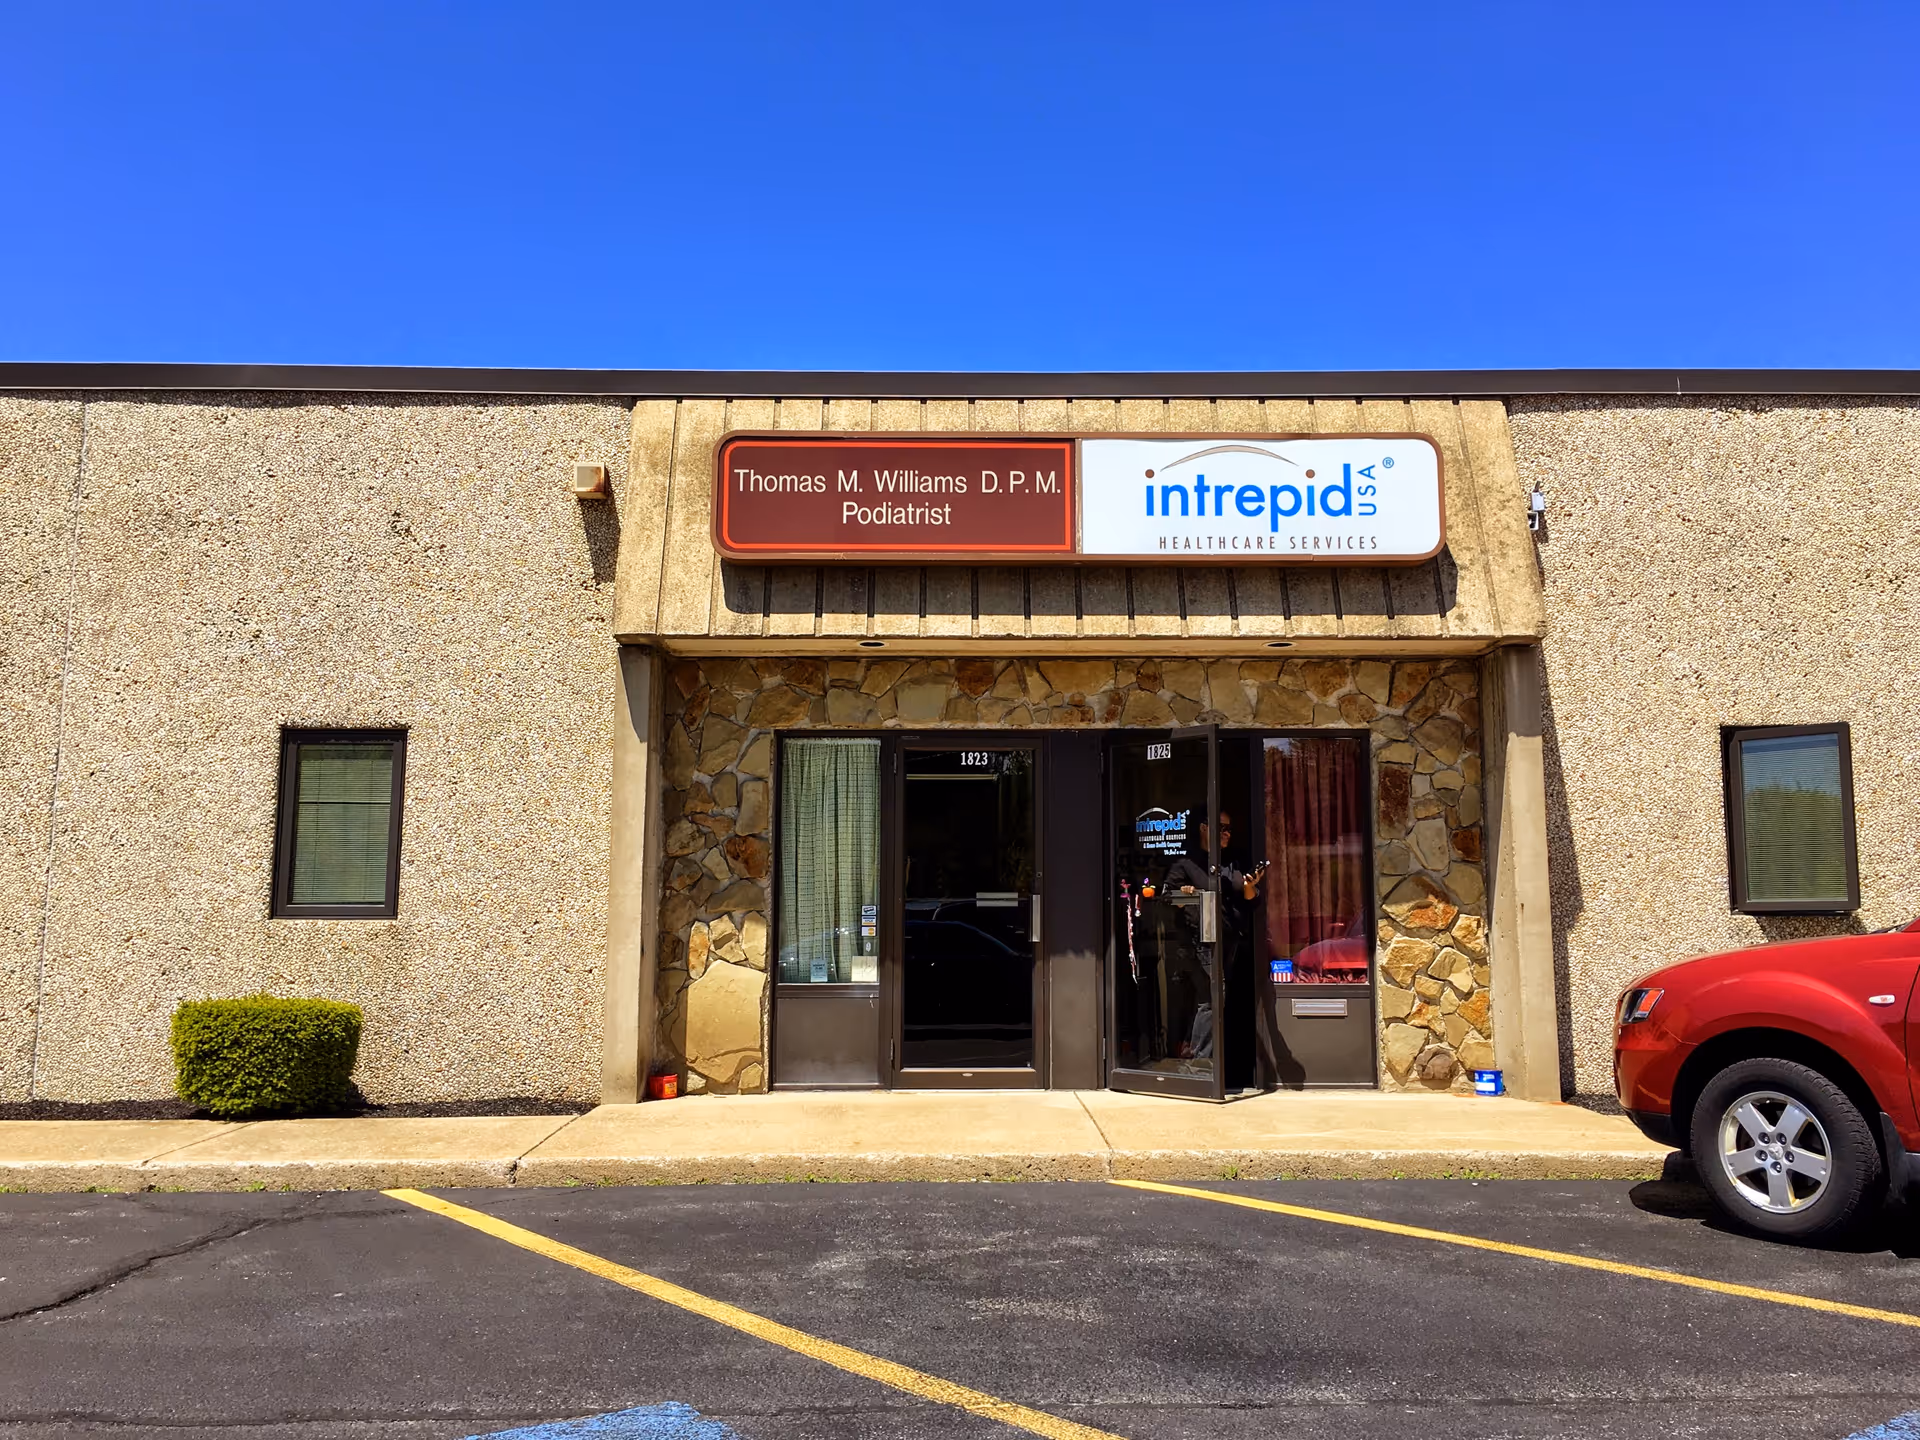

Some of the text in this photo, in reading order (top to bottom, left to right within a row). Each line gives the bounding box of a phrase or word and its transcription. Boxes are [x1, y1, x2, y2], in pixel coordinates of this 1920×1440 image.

[734, 469, 827, 493] Thomas
[837, 470, 863, 493] M.
[874, 470, 968, 493] Williams
[1357, 464, 1378, 516] USA
[1145, 463, 1353, 532] intrepid
[842, 501, 952, 525] Podiatrist
[1158, 536, 1377, 550] HEALTHCARE SERVICES
[960, 751, 988, 766] 1823
[1148, 743, 1170, 760] 1825
[1136, 811, 1181, 836] intrepid
